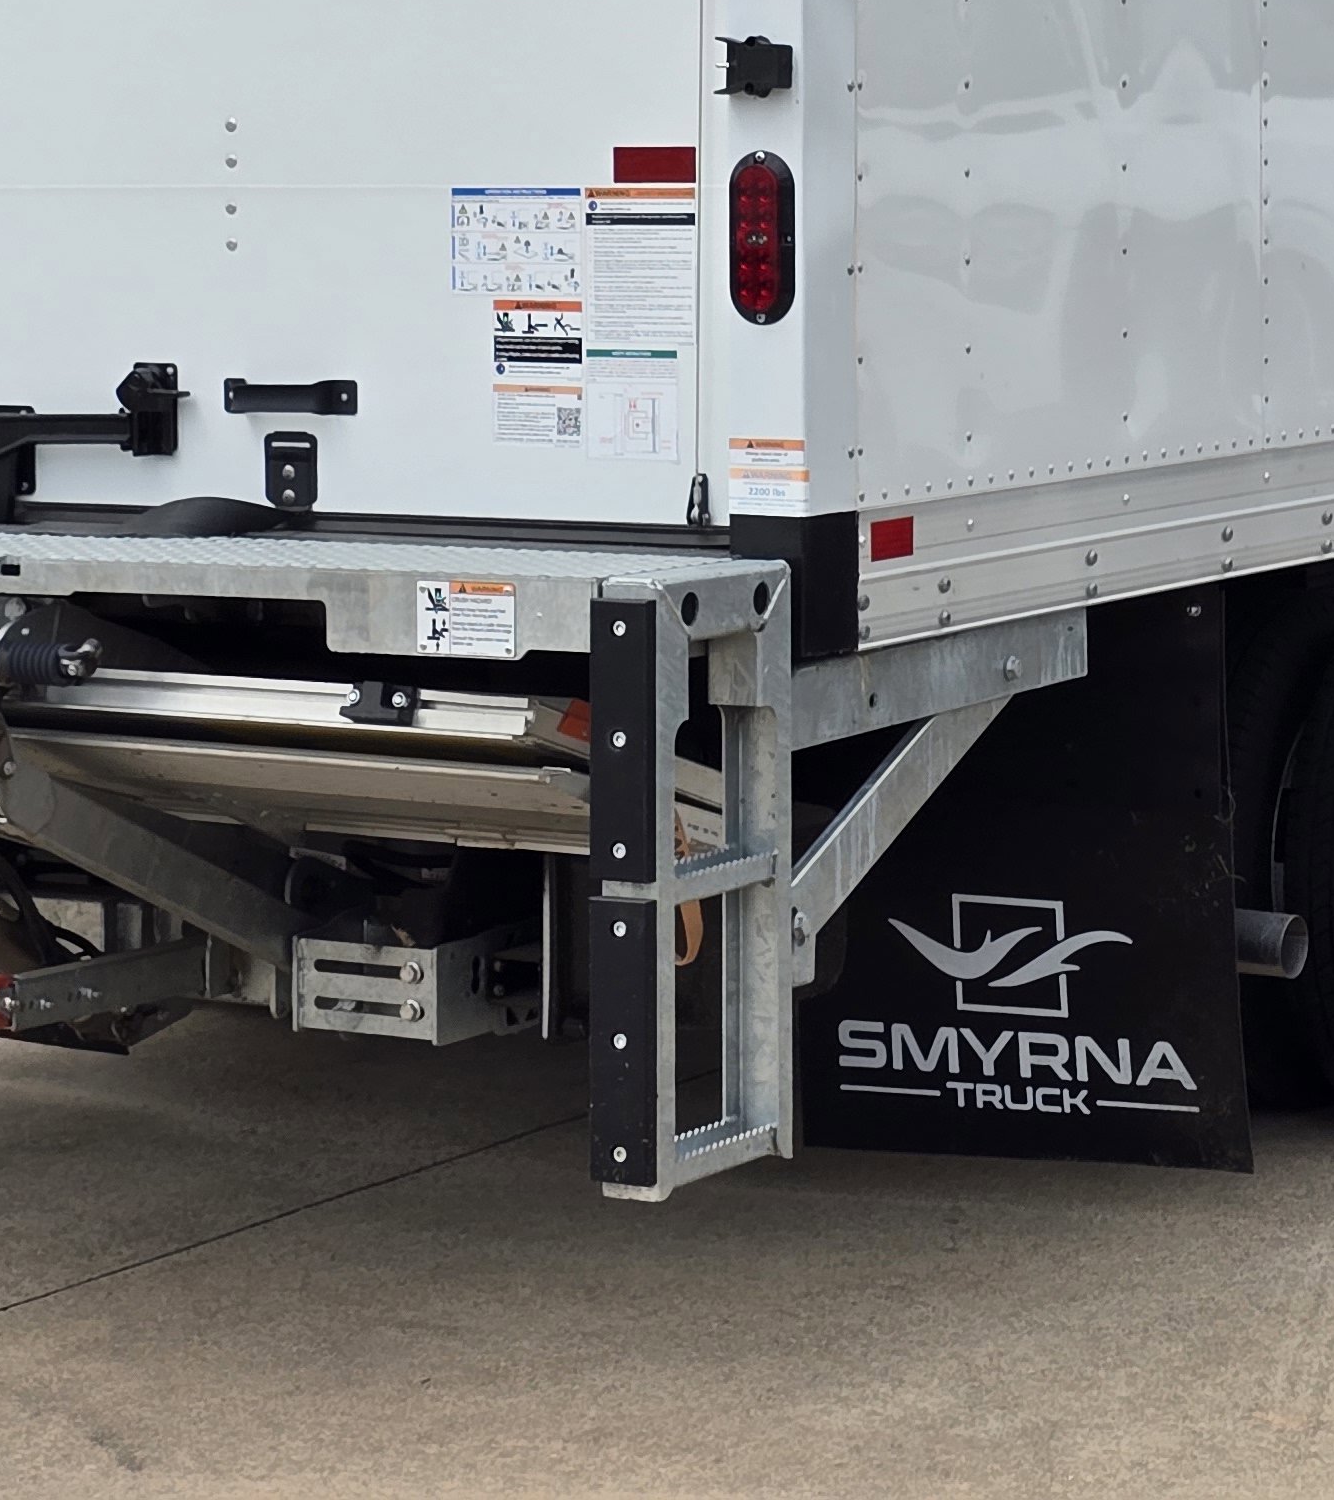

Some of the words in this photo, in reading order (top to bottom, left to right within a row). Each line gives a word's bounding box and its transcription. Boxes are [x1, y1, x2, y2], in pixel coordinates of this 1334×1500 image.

[748, 487, 770, 497] 2200
[772, 488, 786, 497] lbs
[837, 1018, 1199, 1092] SMYRNA
[945, 1080, 1092, 1115] TRUCK
